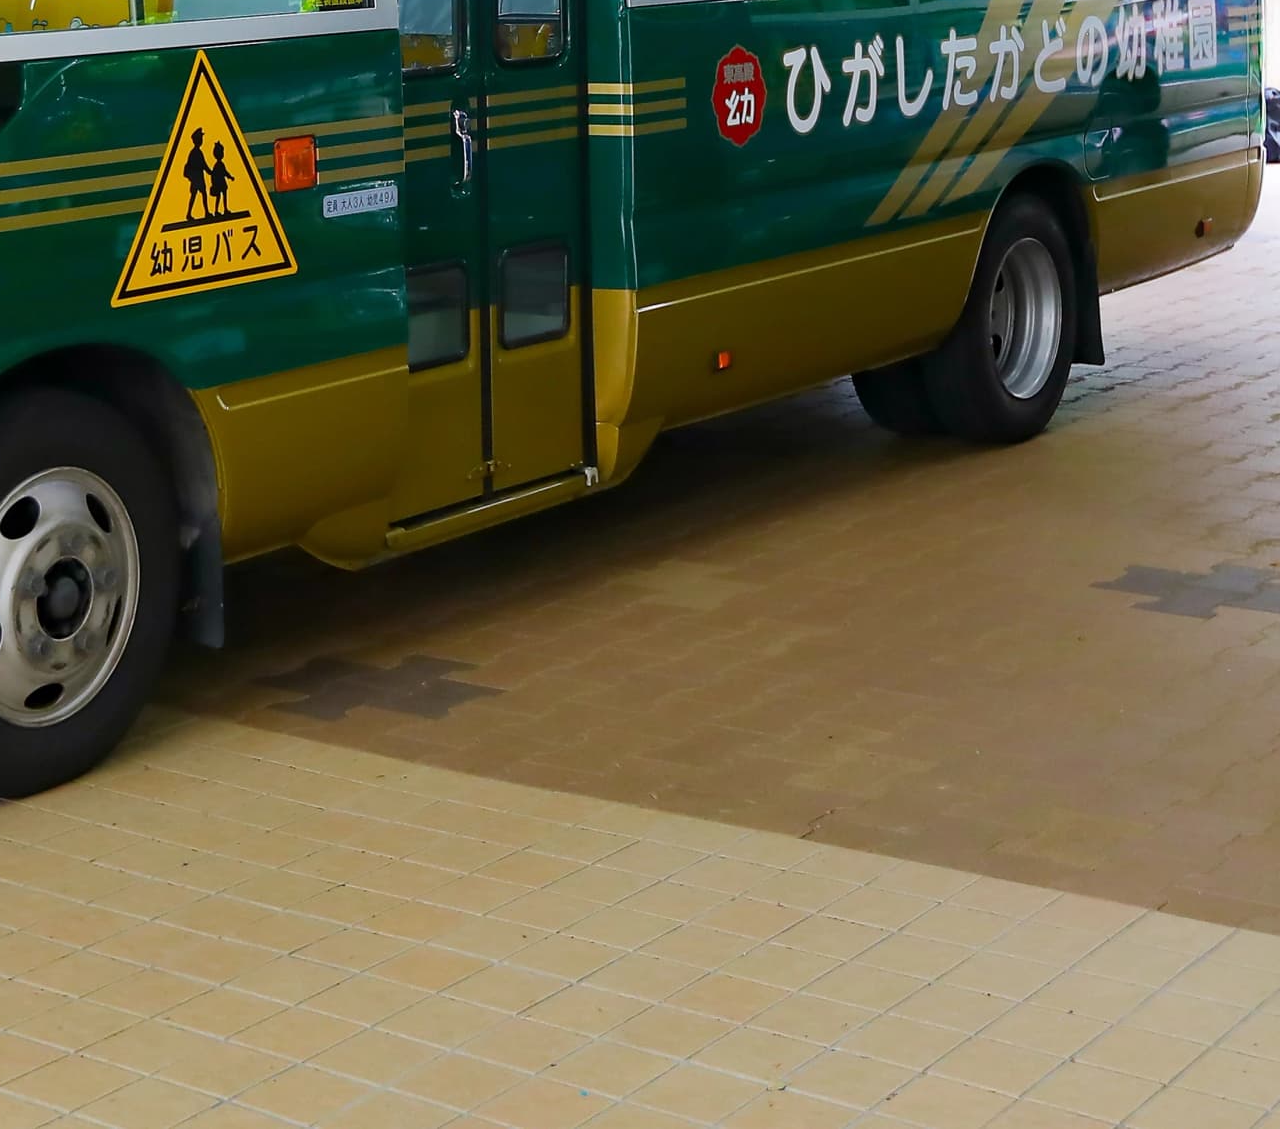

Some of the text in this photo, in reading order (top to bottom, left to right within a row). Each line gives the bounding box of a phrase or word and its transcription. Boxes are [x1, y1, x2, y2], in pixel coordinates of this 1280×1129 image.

[725, 87, 755, 126] 幼
[150, 225, 261, 277] 幼児バス
